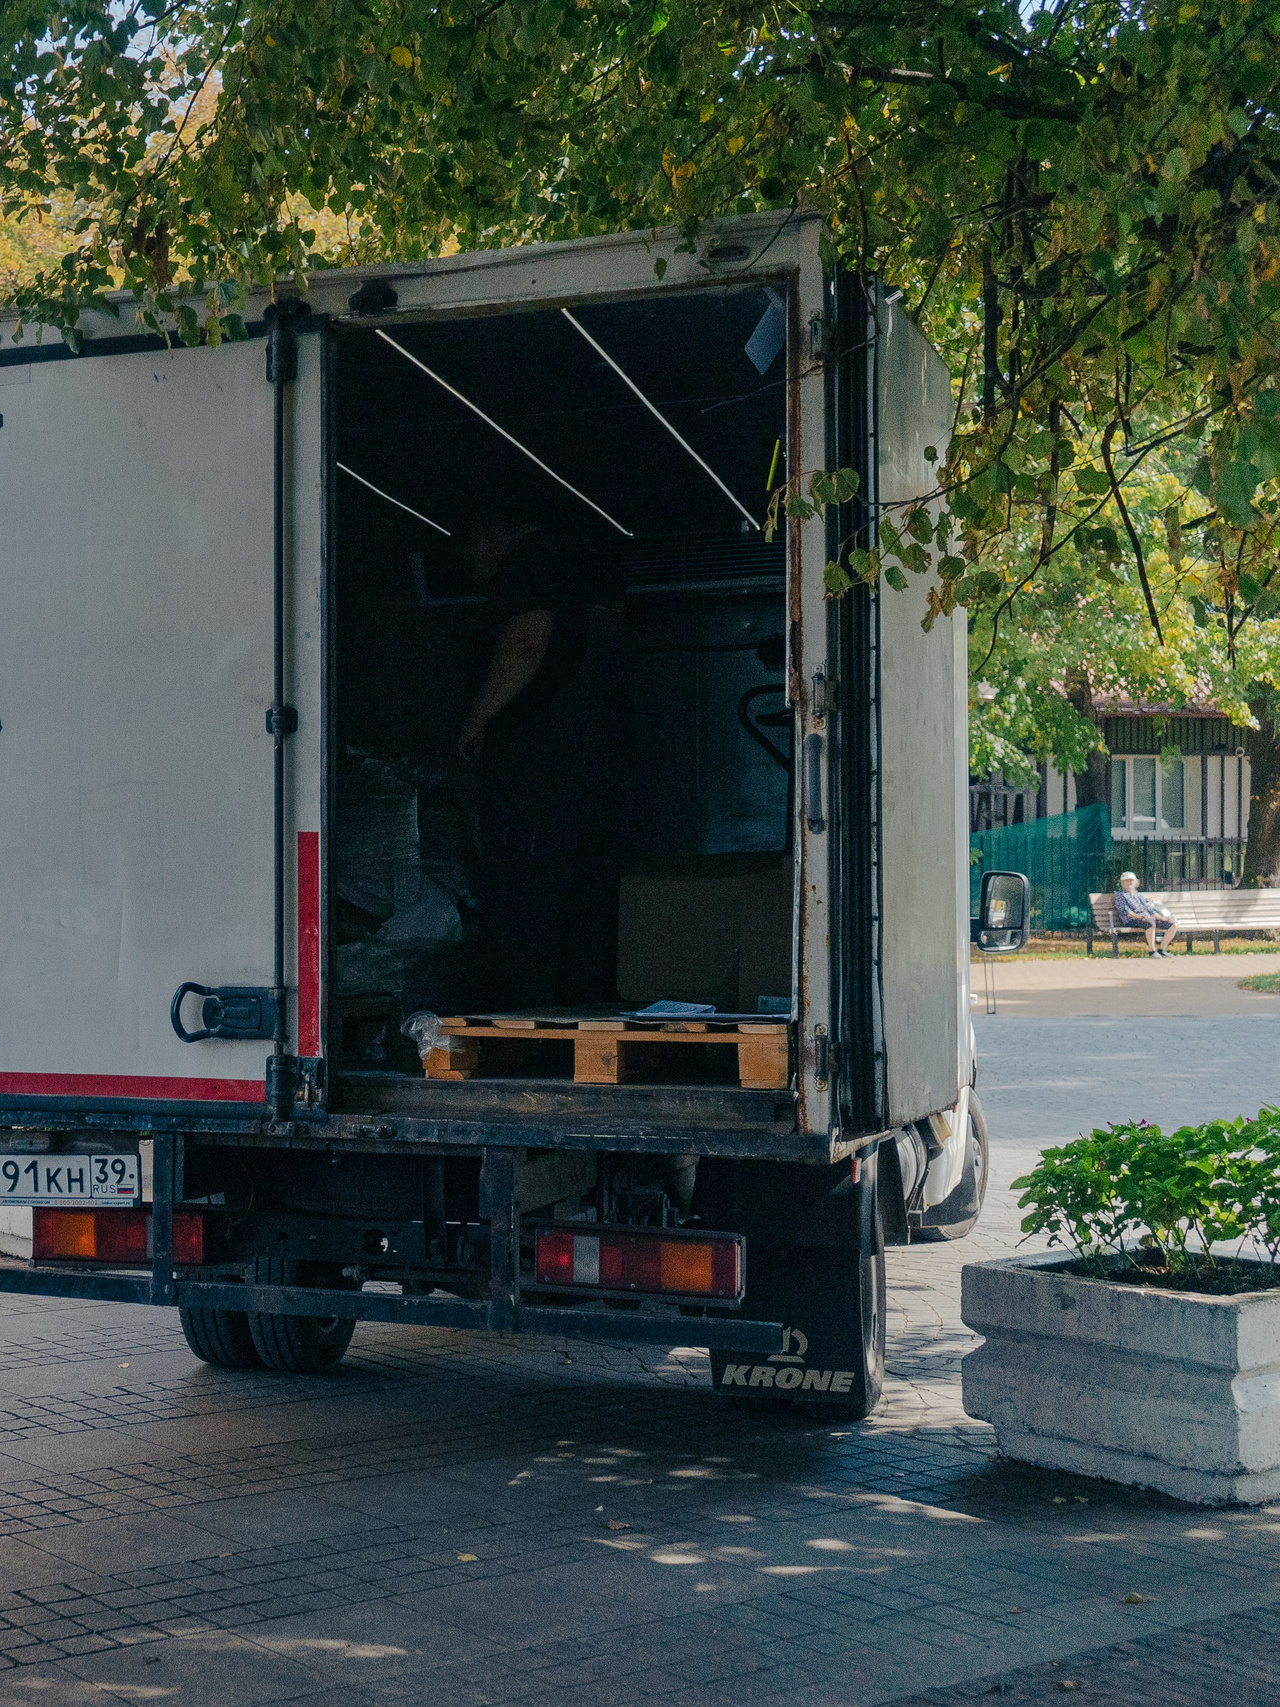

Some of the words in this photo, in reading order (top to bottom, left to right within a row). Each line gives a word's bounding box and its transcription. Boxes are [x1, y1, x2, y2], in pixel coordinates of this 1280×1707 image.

[94, 1158, 126, 1184] 39
[93, 1183, 117, 1194] RUS
[722, 1364, 855, 1393] KRONE
